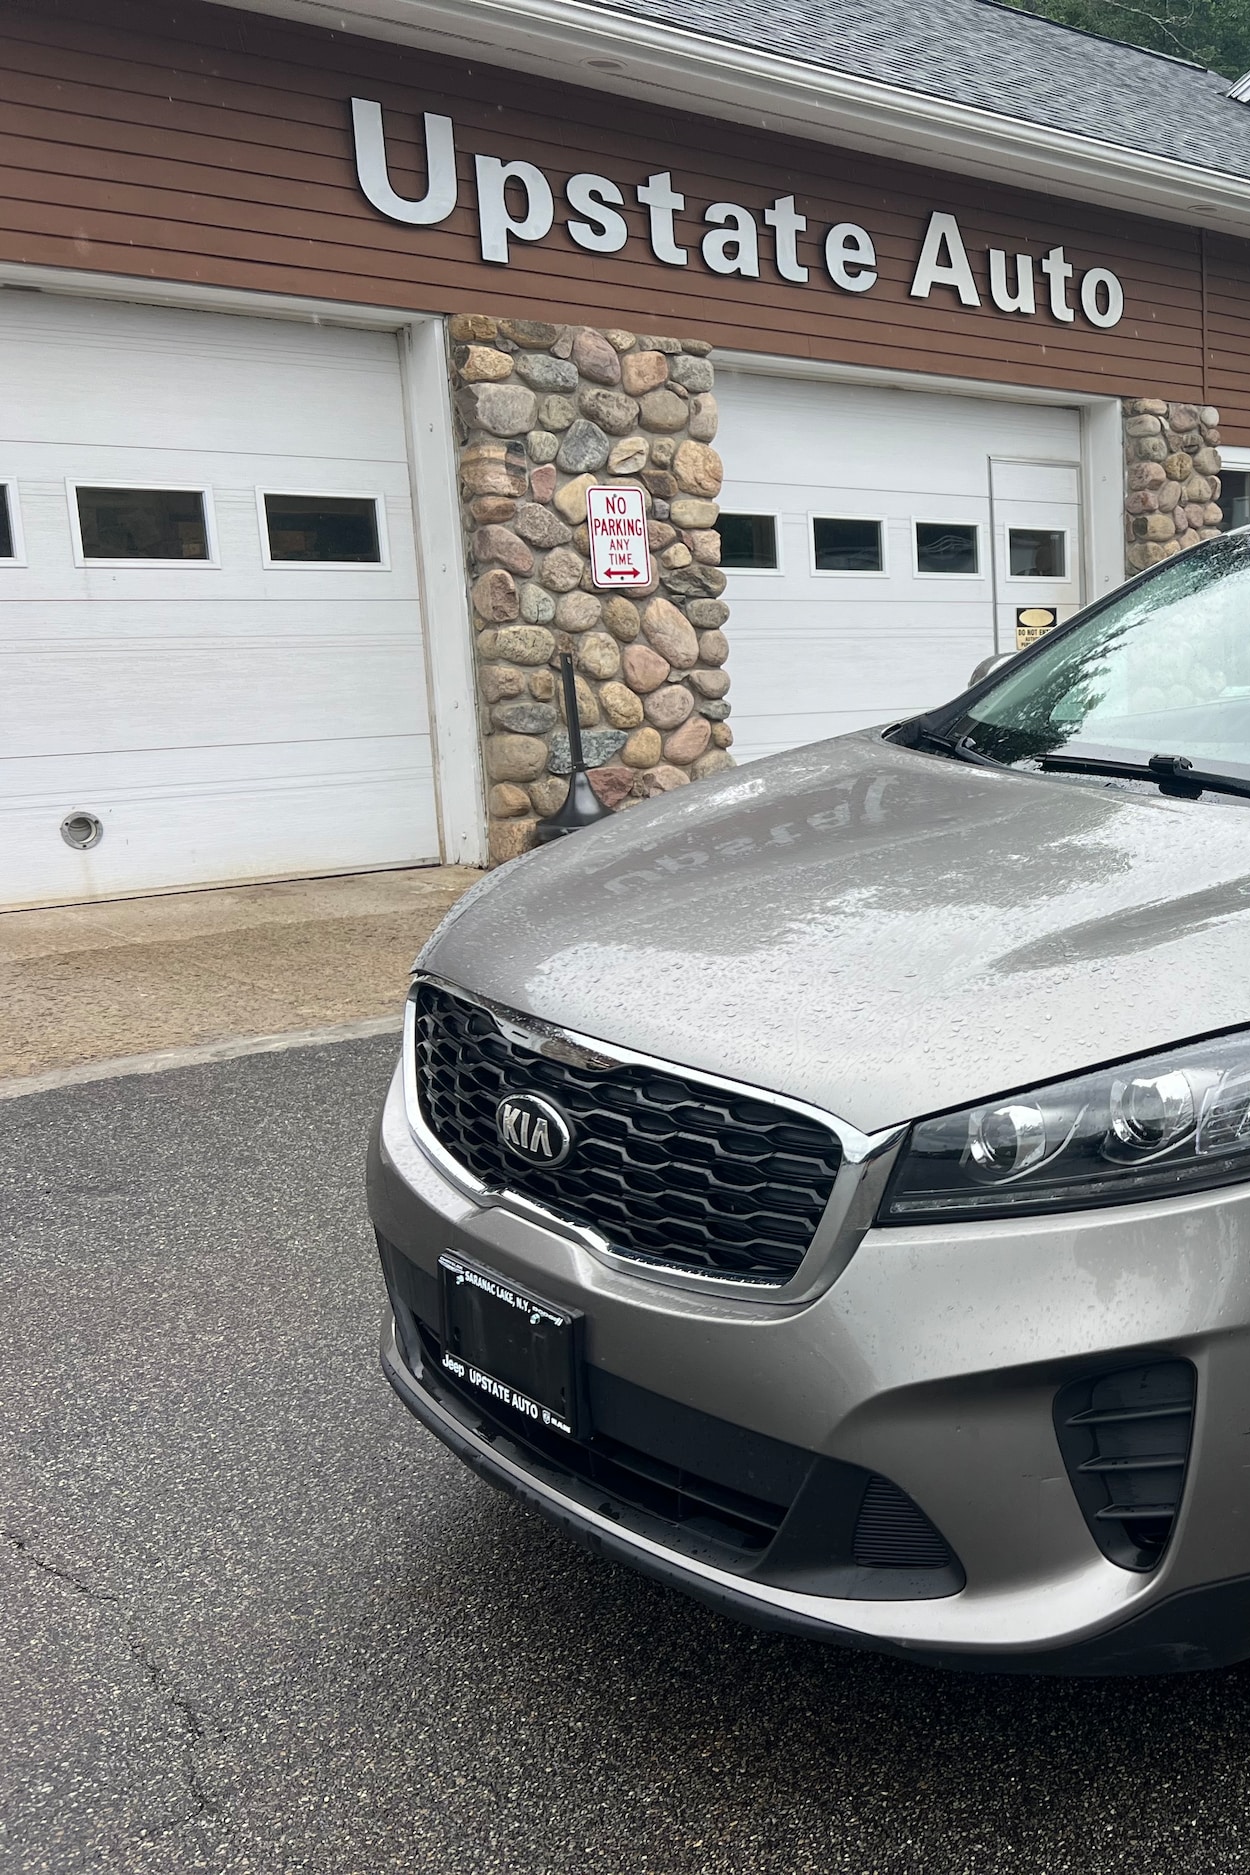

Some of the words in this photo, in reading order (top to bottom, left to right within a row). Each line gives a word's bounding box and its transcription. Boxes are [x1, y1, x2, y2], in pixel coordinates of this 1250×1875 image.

[350, 96, 879, 294] Upstate
[910, 210, 1126, 330] Auto
[605, 496, 626, 514] NO
[594, 518, 642, 536] PARKING
[609, 538, 630, 551] ANY
[608, 553, 633, 565] TIME
[503, 1103, 553, 1157] KIA
[464, 1271, 496, 1295] SARANAC
[496, 1286, 516, 1307] LAKE,
[442, 1354, 465, 1377] Jeep
[469, 1368, 510, 1403] UPSTATE
[511, 1393, 538, 1419] AUTO
